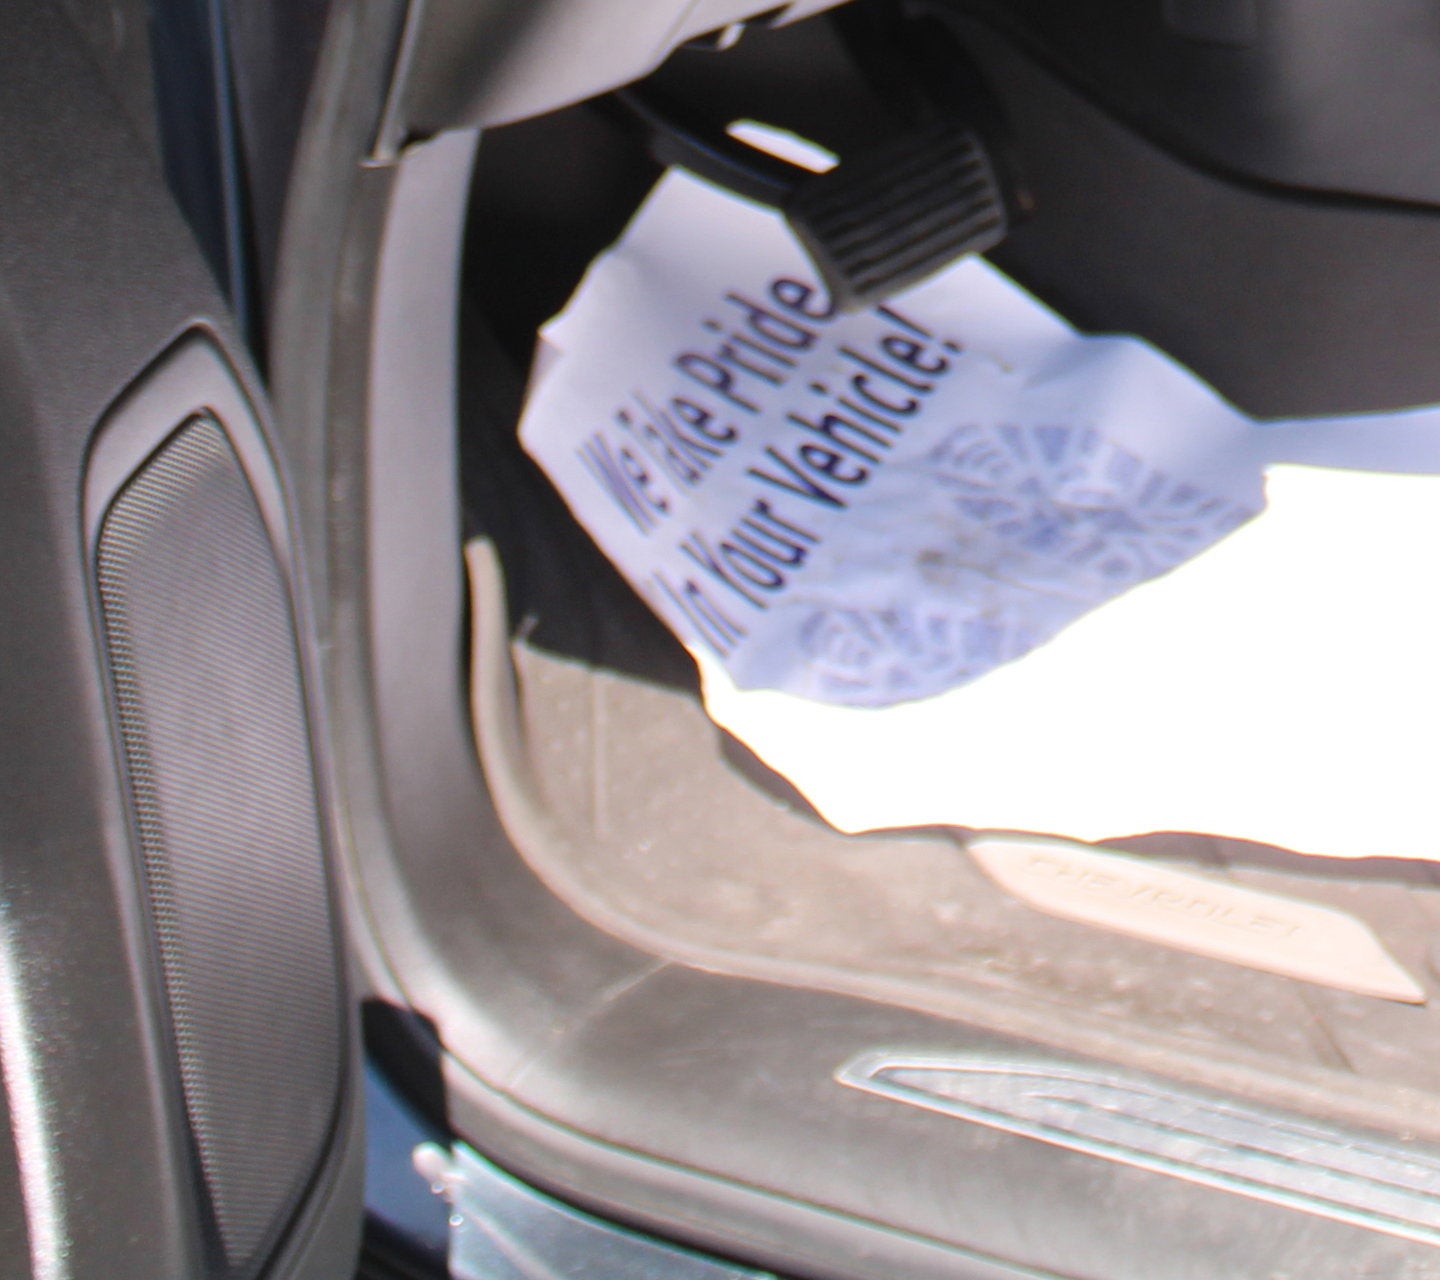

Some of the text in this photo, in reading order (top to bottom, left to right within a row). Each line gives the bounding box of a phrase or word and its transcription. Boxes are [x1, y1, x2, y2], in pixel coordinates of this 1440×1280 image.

[673, 276, 838, 415] Pride
[746, 303, 963, 509] Vehicle!
[678, 497, 821, 610] Your
